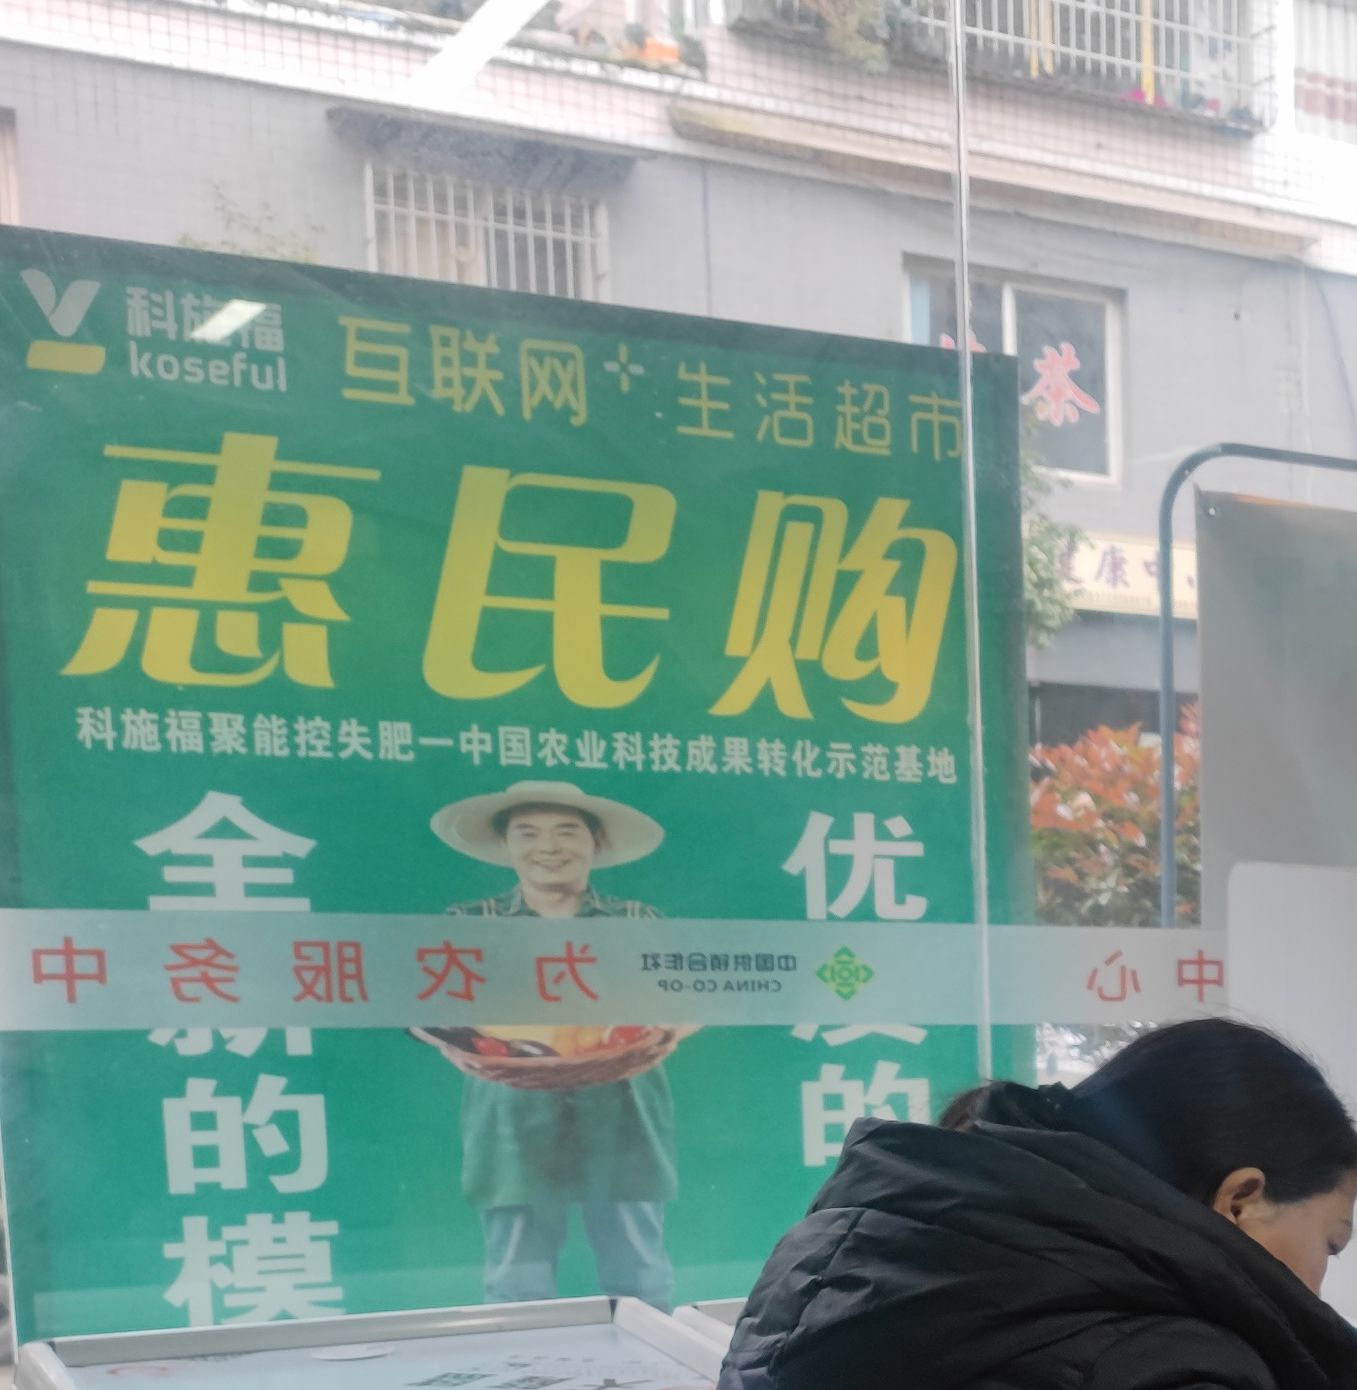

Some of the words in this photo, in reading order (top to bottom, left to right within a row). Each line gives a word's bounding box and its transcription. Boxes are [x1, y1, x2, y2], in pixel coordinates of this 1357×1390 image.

[128, 341, 288, 393] koseful
[60, 431, 958, 726] 惠民购
[132, 789, 347, 1327] 全的模
